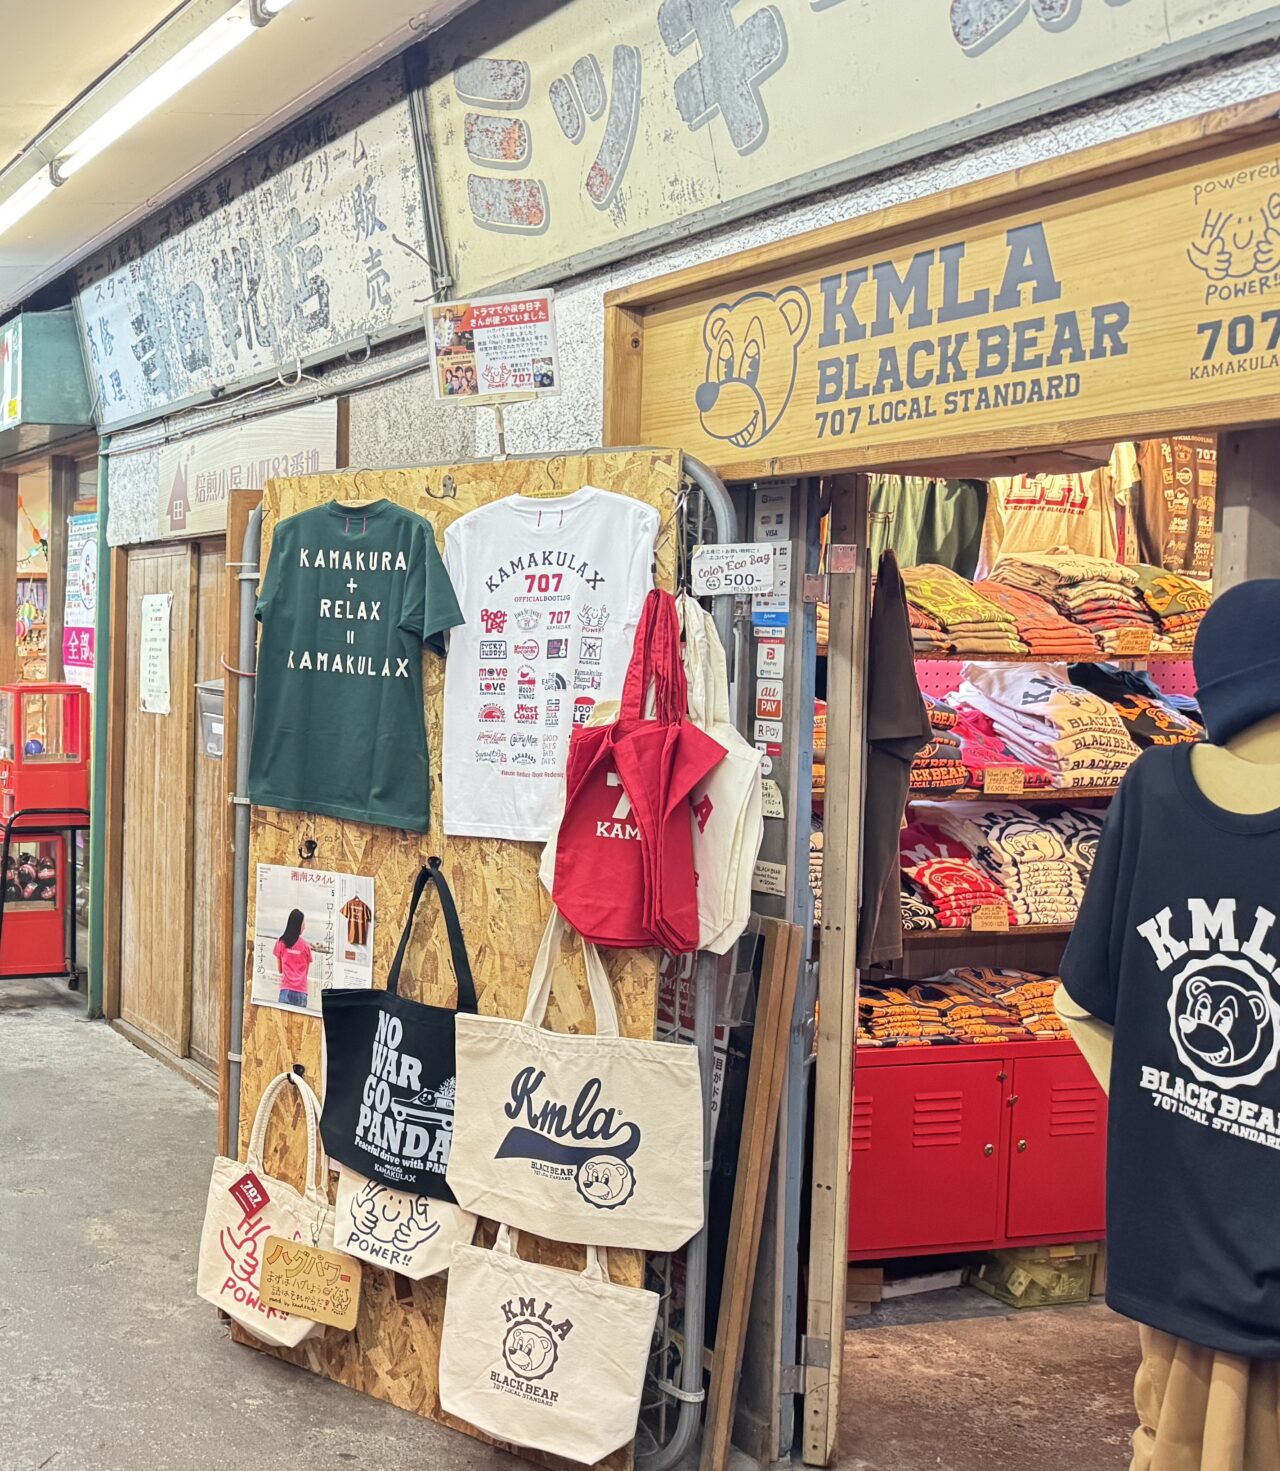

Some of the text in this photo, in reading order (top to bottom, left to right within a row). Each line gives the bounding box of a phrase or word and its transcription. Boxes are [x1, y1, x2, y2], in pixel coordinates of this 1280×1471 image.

[819, 221, 1061, 348] KMLA
[470, 311, 546, 327] さんが使っていました
[473, 302, 542, 317] ドラマで小泉今日子
[1197, 310, 1280, 361] 707
[512, 373, 532, 383] 707
[815, 373, 1081, 439] 707 LOCAL STANDARD
[1197, 448, 1217, 460] 707
[195, 465, 242, 503] 焙煎小屋
[765, 529, 778, 537] VISA
[299, 548, 408, 571] KAMAKURA
[698, 554, 770, 578] Color Eco Bag
[485, 550, 605, 594] KAMAKULAX
[524, 573, 563, 593] 707
[320, 599, 381, 622] RELAX
[481, 608, 507, 622] Boot
[549, 611, 570, 624] 707
[485, 619, 506, 633] Leg
[287, 650, 410, 678] KAMAKULAX
[761, 687, 778, 697] au
[514, 711, 539, 720] Coast
[517, 704, 538, 713] West
[761, 701, 777, 712] PAY
[765, 725, 780, 738] Pay
[1069, 717, 1109, 729] BLACK
[1073, 734, 1113, 750] BLACK
[1072, 776, 1110, 787] BLACK
[291, 871, 335, 884] 湘南スタイル
[1136, 898, 1280, 986] KML
[375, 1009, 403, 1050] NO
[371, 1042, 423, 1092] WAR
[363, 1073, 391, 1114] GO
[504, 1066, 616, 1140] Kmla
[1139, 1065, 1280, 1136] BLACK BEA
[1152, 1093, 1177, 1113] 707
[1179, 1103, 1209, 1126] LOCAL
[356, 1103, 452, 1164] PANDA
[354, 1136, 380, 1160] Peaceful
[380, 1149, 401, 1166] drive
[402, 1158, 424, 1170] with
[374, 1163, 416, 1182] KAMAKULAX
[243, 1180, 262, 1203] 707
[346, 1231, 413, 1267] POWER!!
[266, 1245, 351, 1286] ハグパワー
[500, 1296, 574, 1341] KMLA
